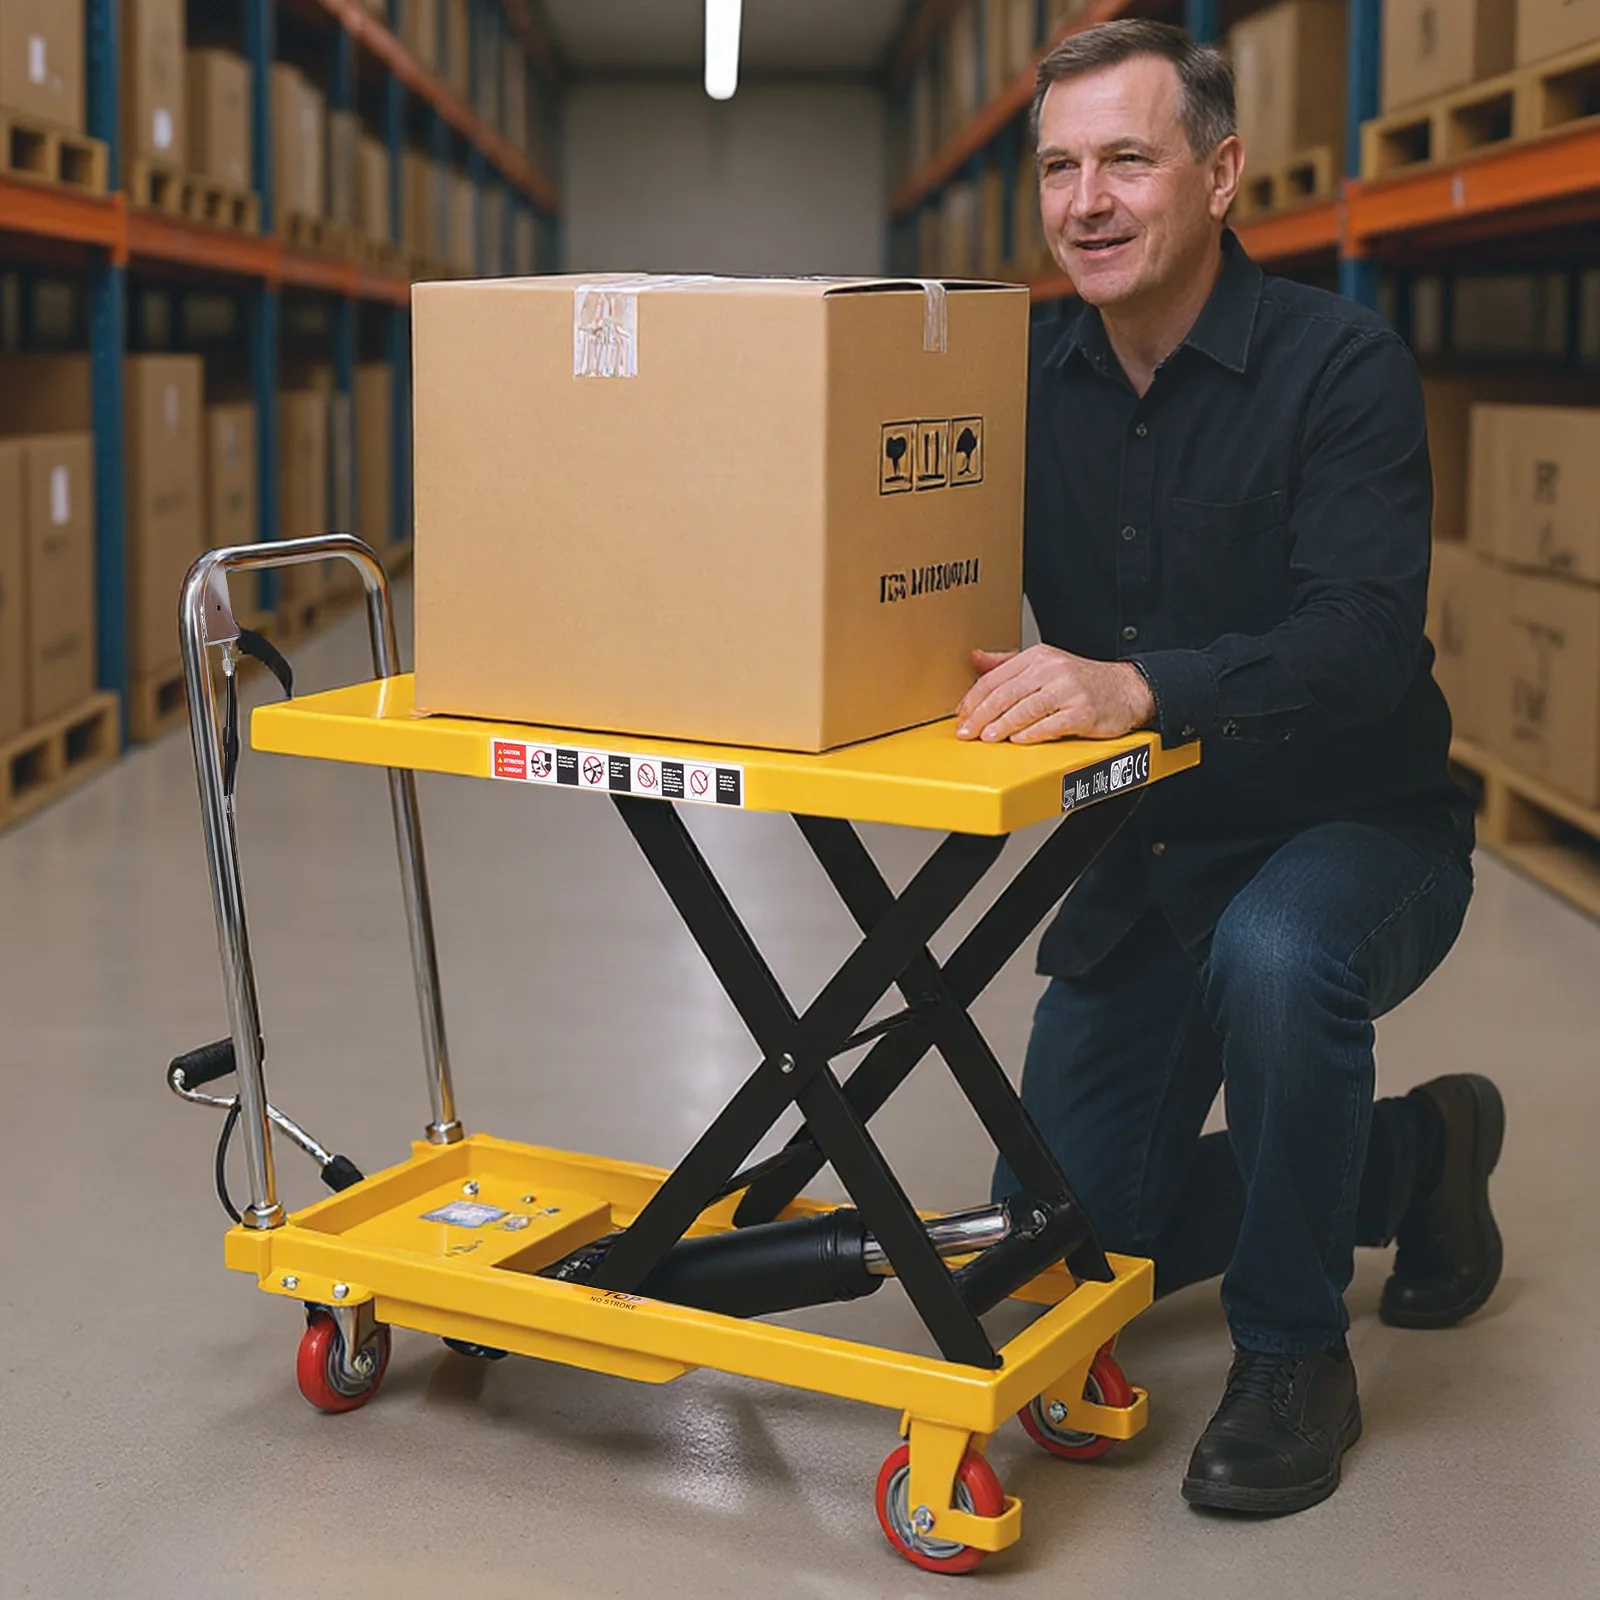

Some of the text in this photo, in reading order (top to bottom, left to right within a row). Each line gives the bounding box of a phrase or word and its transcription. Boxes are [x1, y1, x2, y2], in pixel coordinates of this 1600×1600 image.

[1076, 779, 1090, 801] Max
[1092, 770, 1108, 794] 150kg
[604, 1290, 641, 1301] TOP
[604, 1299, 637, 1310] STROKE
